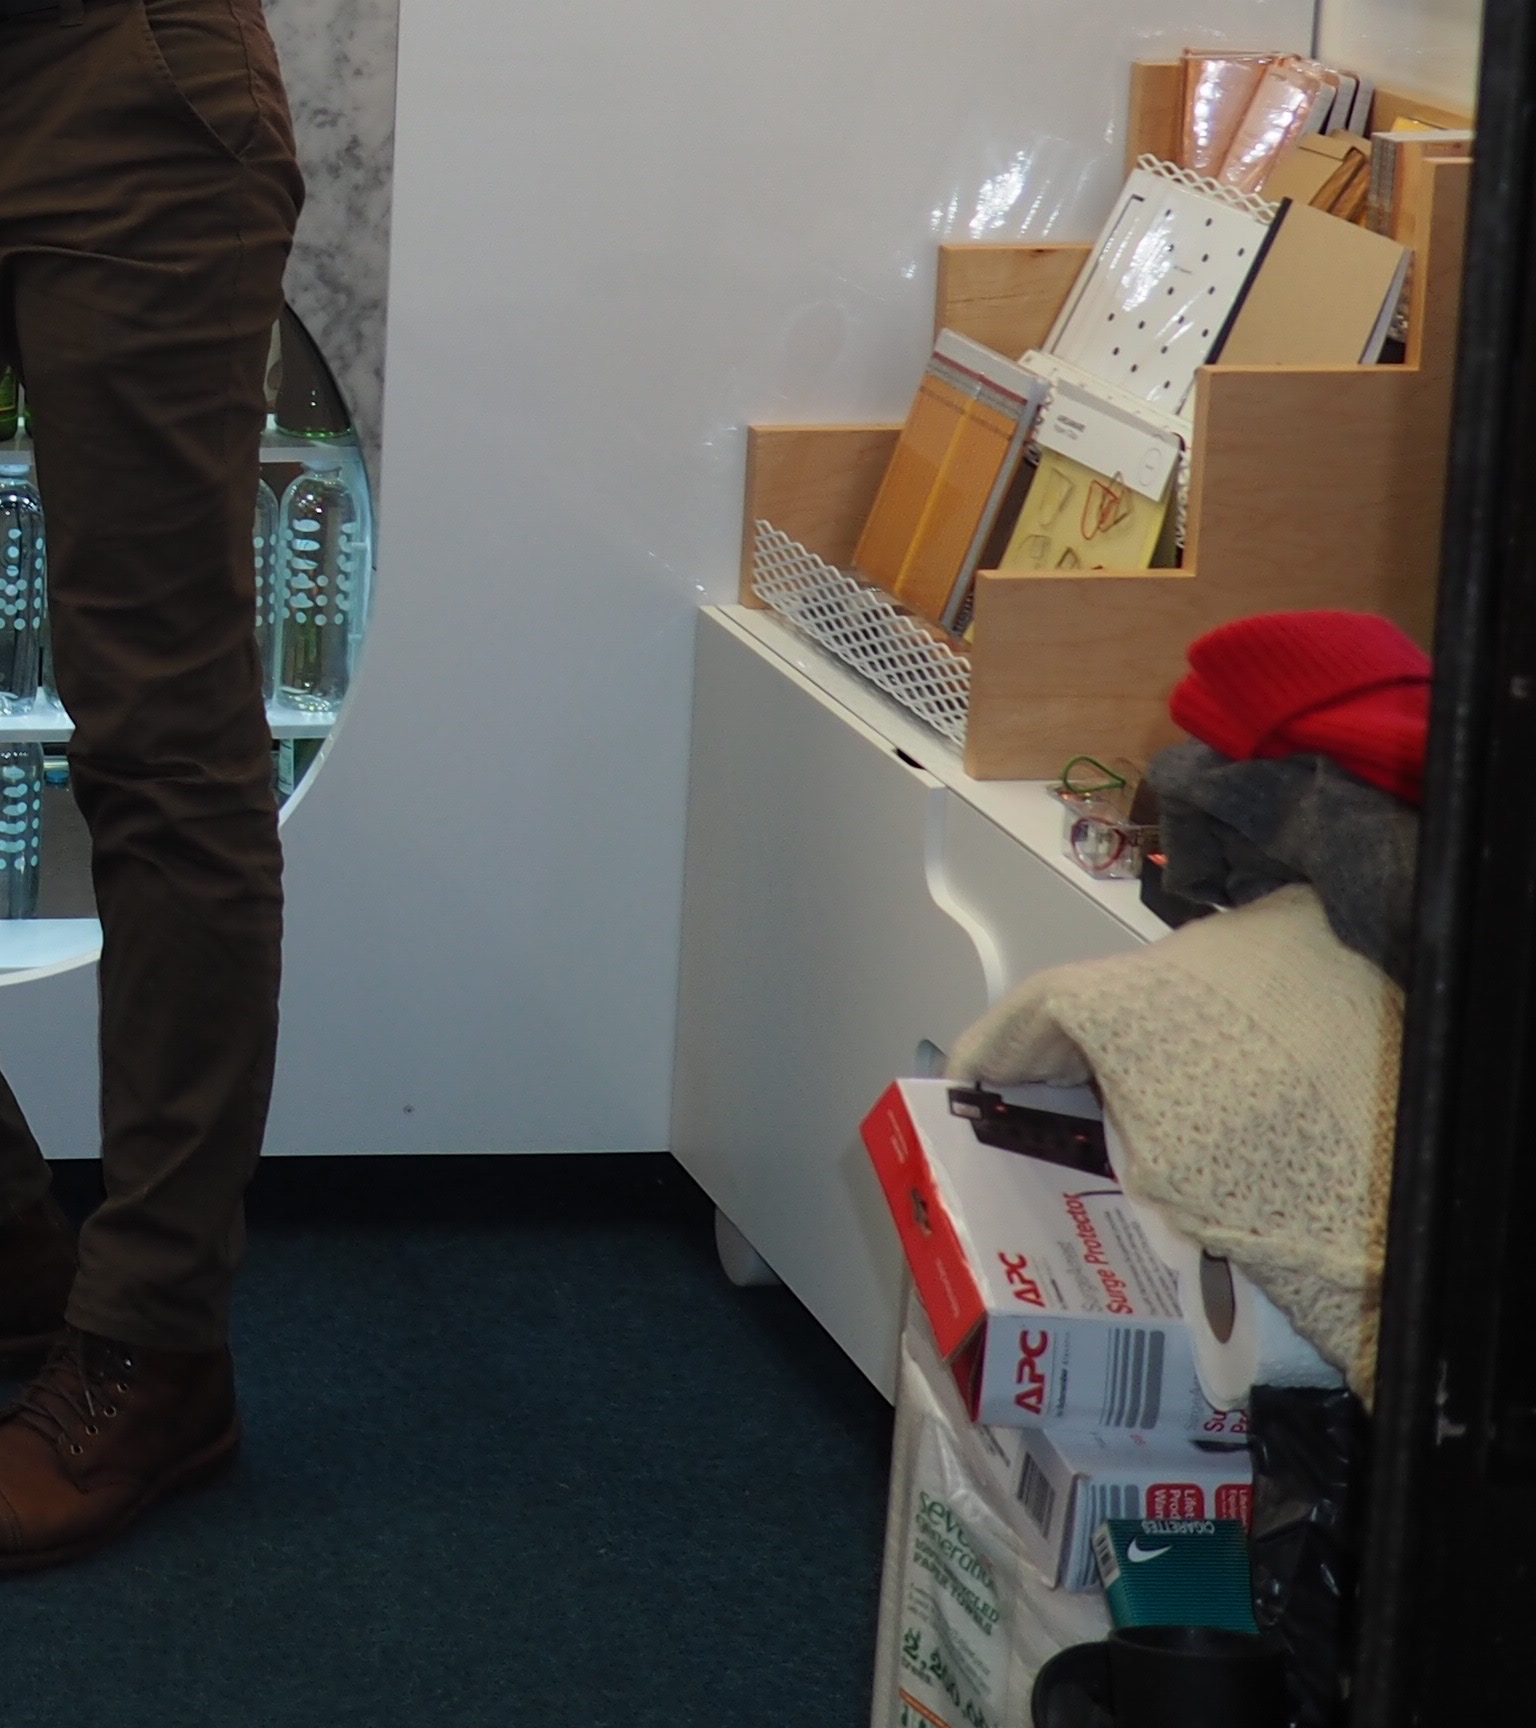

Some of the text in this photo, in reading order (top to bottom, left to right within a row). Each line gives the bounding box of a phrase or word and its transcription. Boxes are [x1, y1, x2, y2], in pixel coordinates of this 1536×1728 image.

[1062, 1191, 1134, 1315] Surge Protector
[998, 1251, 1045, 1308] APC
[1014, 1329, 1049, 1416] APC
[1170, 1489, 1181, 1519] Prod
[1184, 1489, 1197, 1519] Lifet
[1141, 1520, 1216, 1534] CIGARETTES
